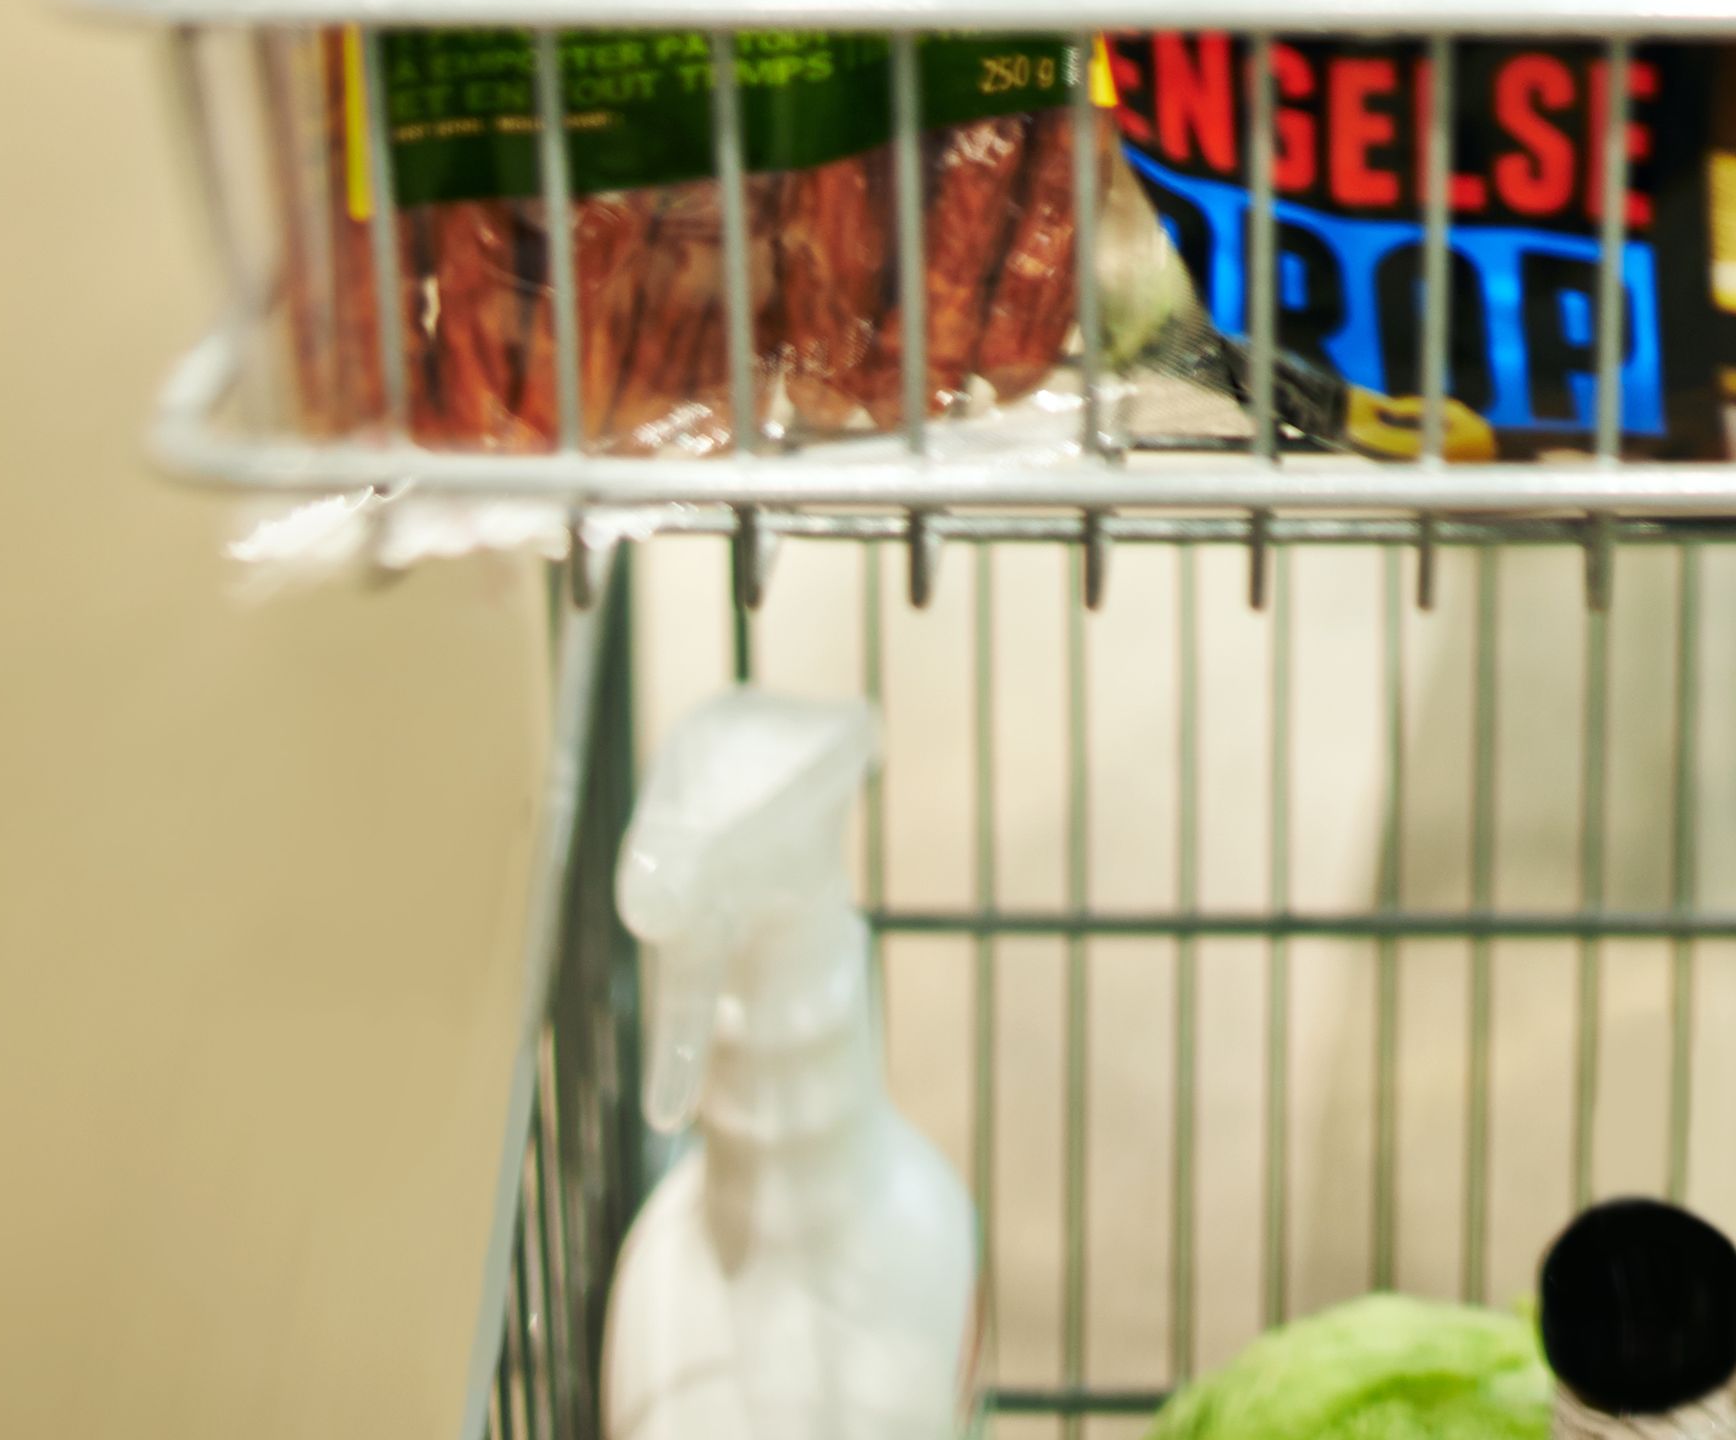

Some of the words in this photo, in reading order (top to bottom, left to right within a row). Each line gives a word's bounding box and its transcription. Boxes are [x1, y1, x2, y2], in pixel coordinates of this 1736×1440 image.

[677, 51, 833, 95] TMPS
[978, 53, 1030, 95] 250
[1102, 29, 1657, 230] ENGELSE
